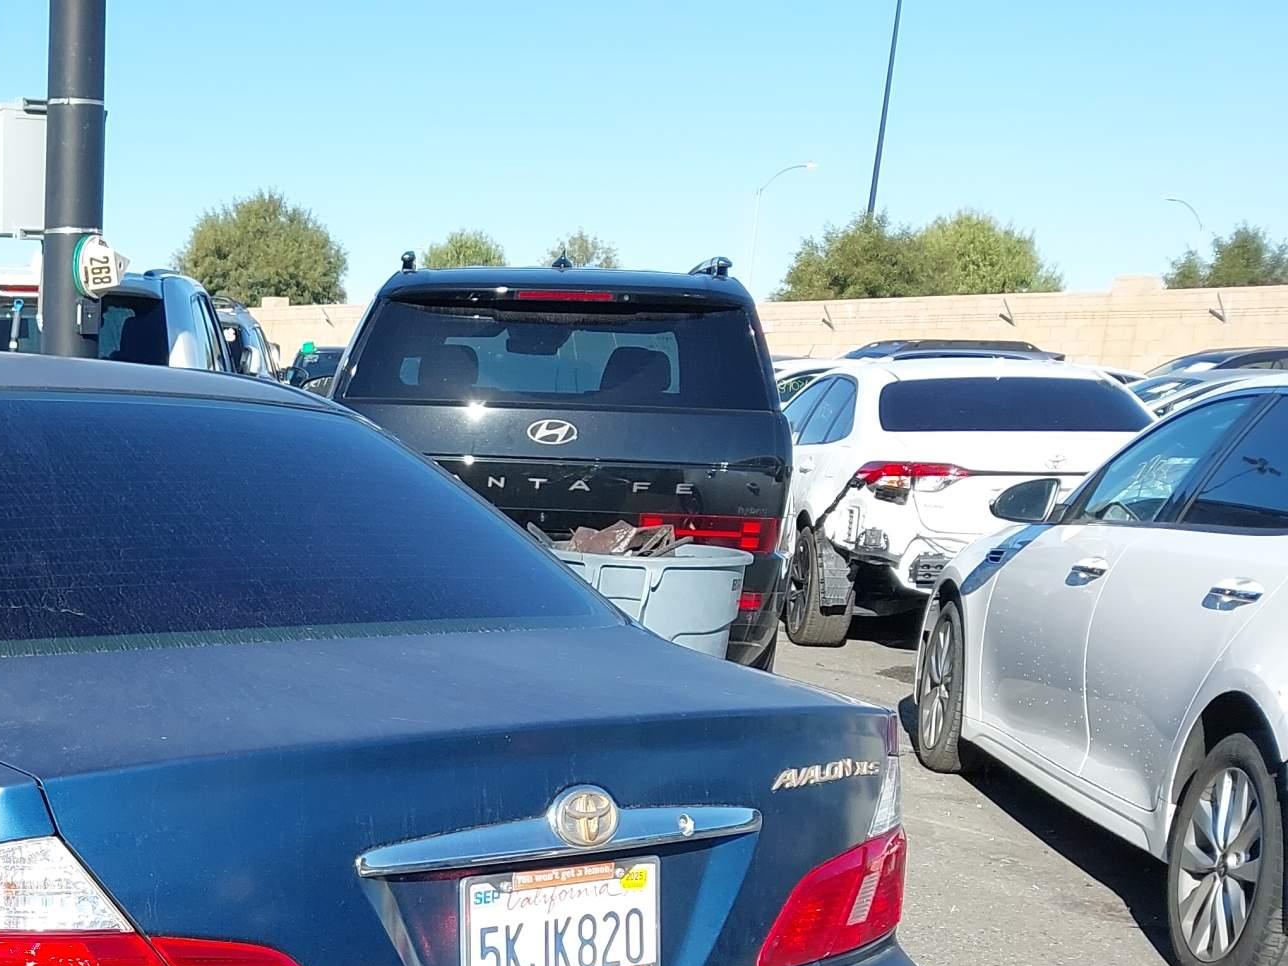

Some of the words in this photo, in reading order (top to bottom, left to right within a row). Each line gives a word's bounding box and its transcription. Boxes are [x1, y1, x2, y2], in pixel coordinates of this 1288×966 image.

[90, 255, 112, 285] 268
[454, 474, 592, 493] NTA
[632, 481, 694, 495] FE
[771, 757, 853, 792] AVALON
[853, 761, 881, 776] XLS
[517, 875, 534, 884] You
[535, 870, 561, 882] won't
[561, 868, 574, 880] get
[626, 871, 644, 881] 2025
[473, 891, 500, 906] SEP
[506, 882, 622, 913] California
